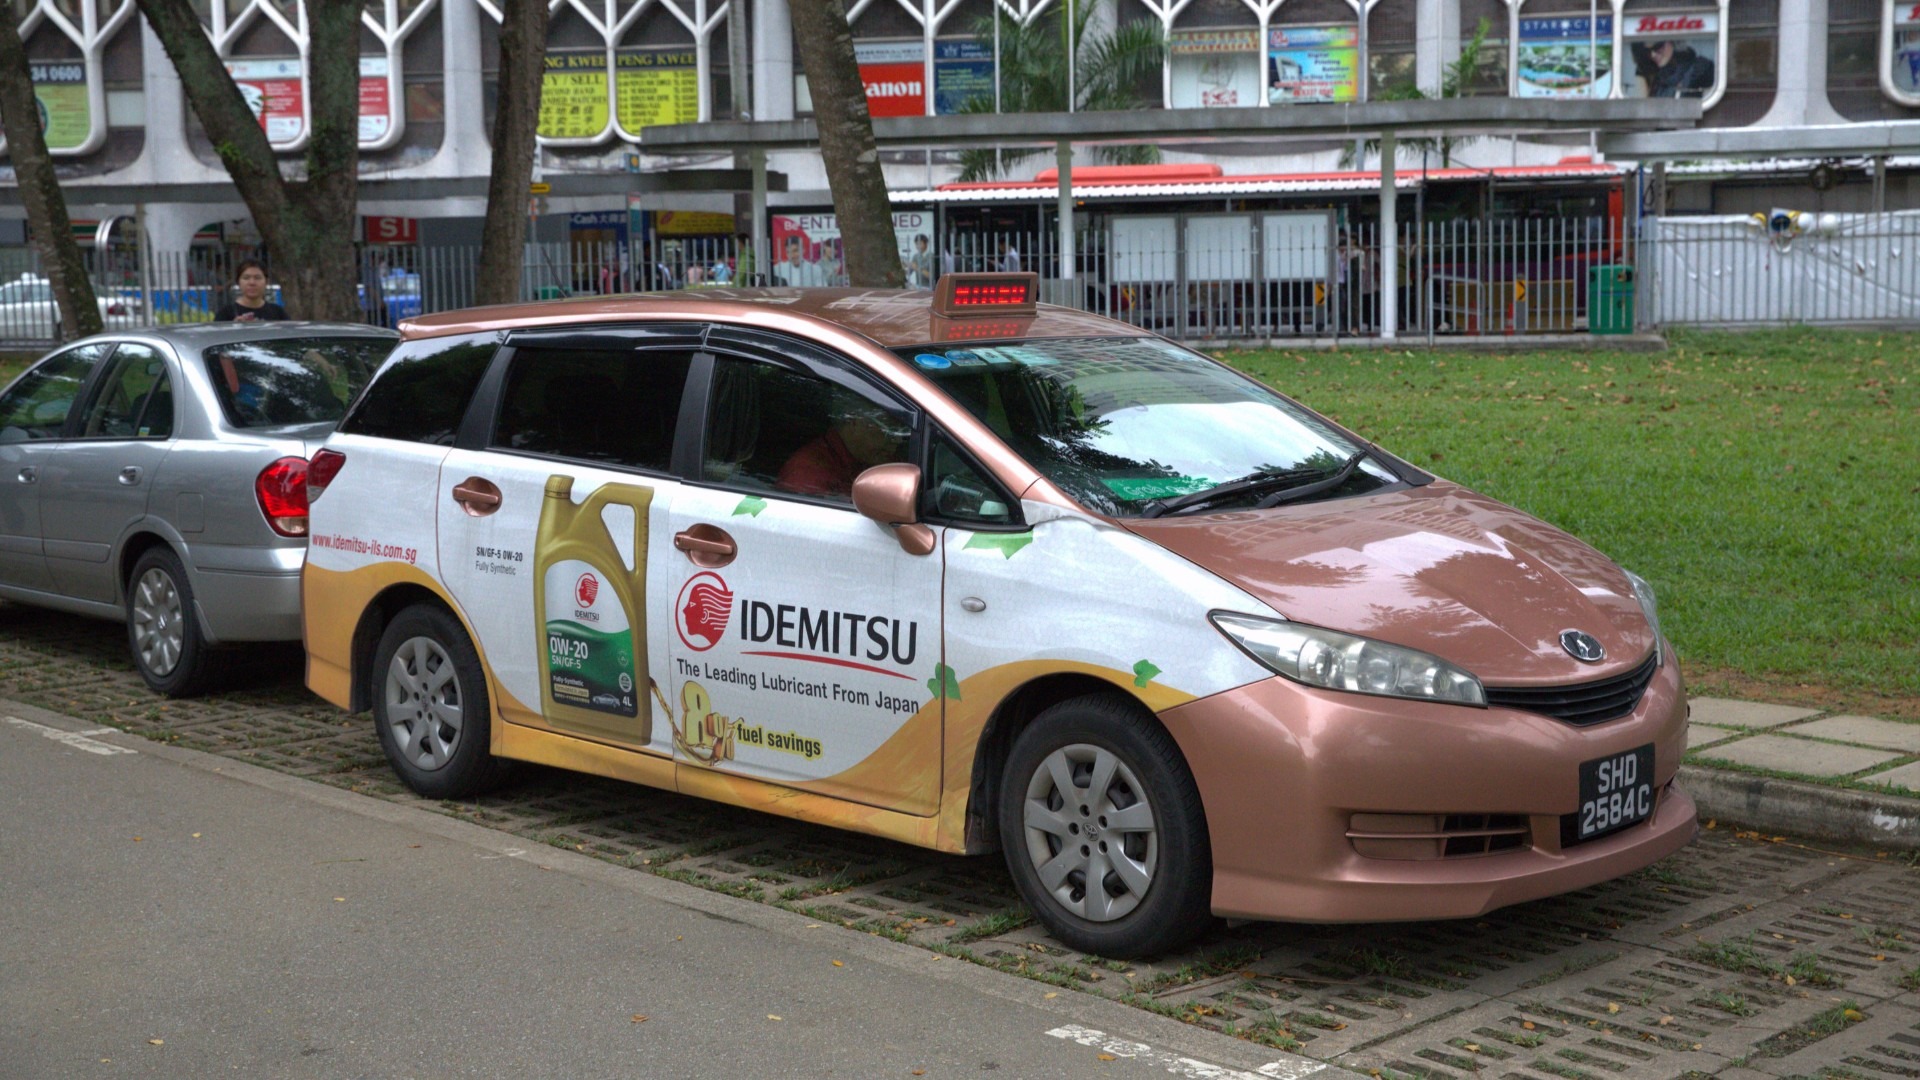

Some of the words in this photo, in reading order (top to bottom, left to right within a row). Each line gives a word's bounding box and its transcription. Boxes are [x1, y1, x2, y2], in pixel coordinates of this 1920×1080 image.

[1524, 20, 1557, 31] STAR
[1573, 17, 1607, 29] CIY
[1636, 14, 1704, 32] Bata
[617, 53, 652, 66] PENG
[657, 53, 696, 65] KWEE
[571, 74, 604, 86] SELL
[861, 80, 922, 97] anon
[312, 533, 417, 565] www.idemitsu-ils.com.sg
[476, 546, 501, 560] SN/GF-5
[475, 560, 489, 574] Fully
[490, 562, 516, 576] Synthetic
[574, 609, 599, 621] IDEMITSU
[740, 599, 917, 666] IDEMITSU
[550, 637, 589, 659] 0W-20
[551, 657, 582, 669] SN/GF-5
[677, 658, 700, 677] The
[704, 663, 757, 690] Leading
[762, 672, 828, 699] Lubricant
[833, 683, 870, 706] From
[875, 691, 920, 715] Japan
[622, 695, 632, 706] 4L
[737, 724, 763, 744] fuel
[767, 731, 821, 758] savings
[1598, 753, 1637, 794] SHD
[1582, 783, 1650, 835] 2584C
